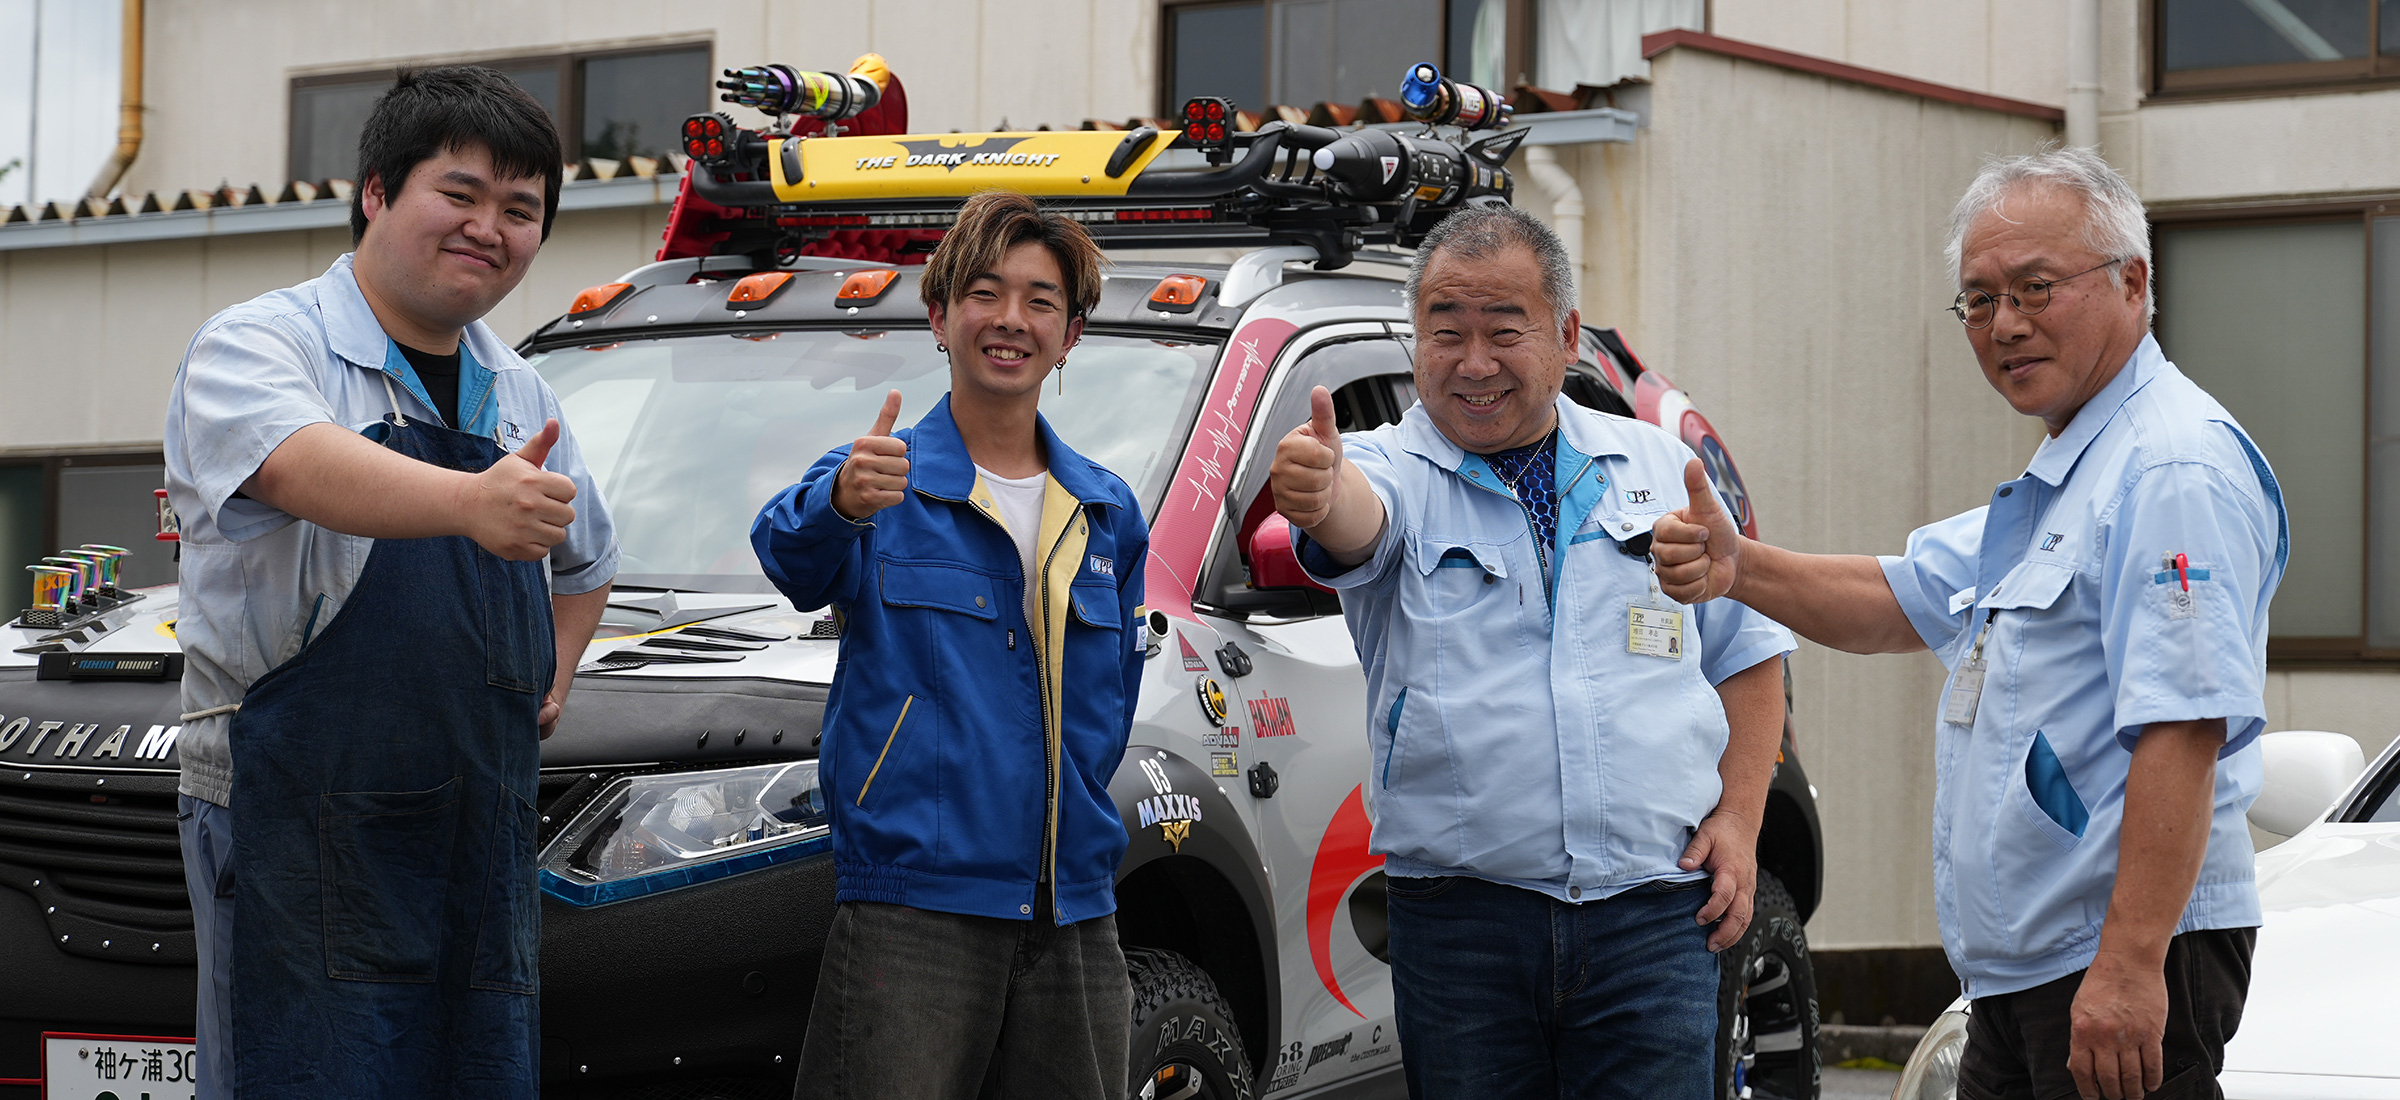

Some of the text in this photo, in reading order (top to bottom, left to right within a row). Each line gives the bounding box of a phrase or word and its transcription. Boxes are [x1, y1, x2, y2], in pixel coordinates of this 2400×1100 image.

[855, 152, 1060, 171] THE DARK KNIGHT
[1624, 489, 1653, 504] CPP
[1092, 557, 1112, 574] CPP
[34, 575, 70, 594] XXIS
[1184, 660, 1206, 668] ADVAN
[1248, 697, 1296, 738] BATMAN
[1203, 733, 1238, 746] ADVAN
[1139, 757, 1172, 795] 03
[1137, 794, 1203, 829] MAXXIS
